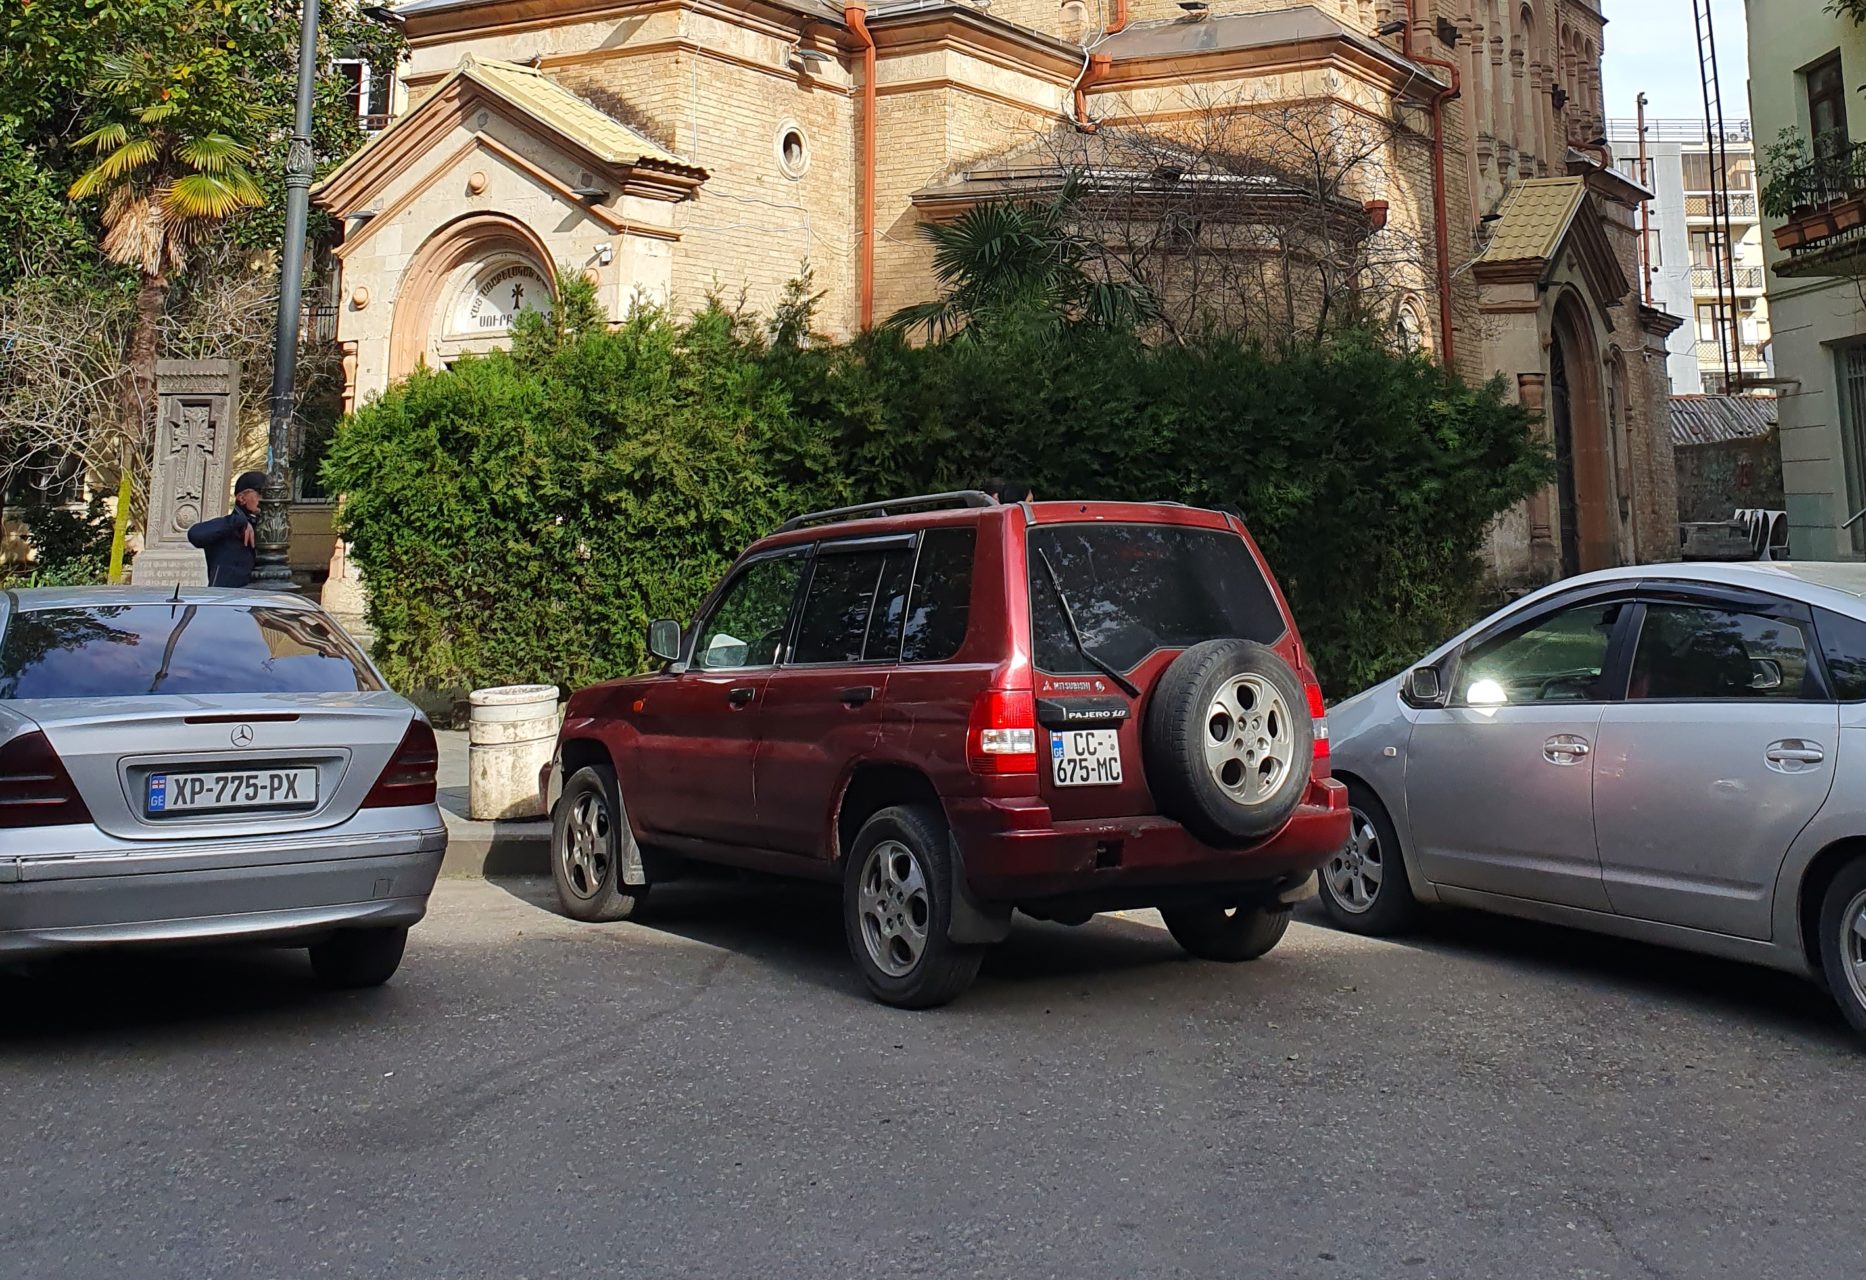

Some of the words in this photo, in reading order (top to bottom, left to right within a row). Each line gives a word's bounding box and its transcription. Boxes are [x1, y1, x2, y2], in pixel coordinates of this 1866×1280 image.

[1068, 711, 1110, 719] PAJERO
[1053, 747, 1063, 757] GE
[1057, 757, 1120, 783] 675-MC
[150, 795, 164, 807] GE
[173, 772, 298, 805] XP-775-PX
